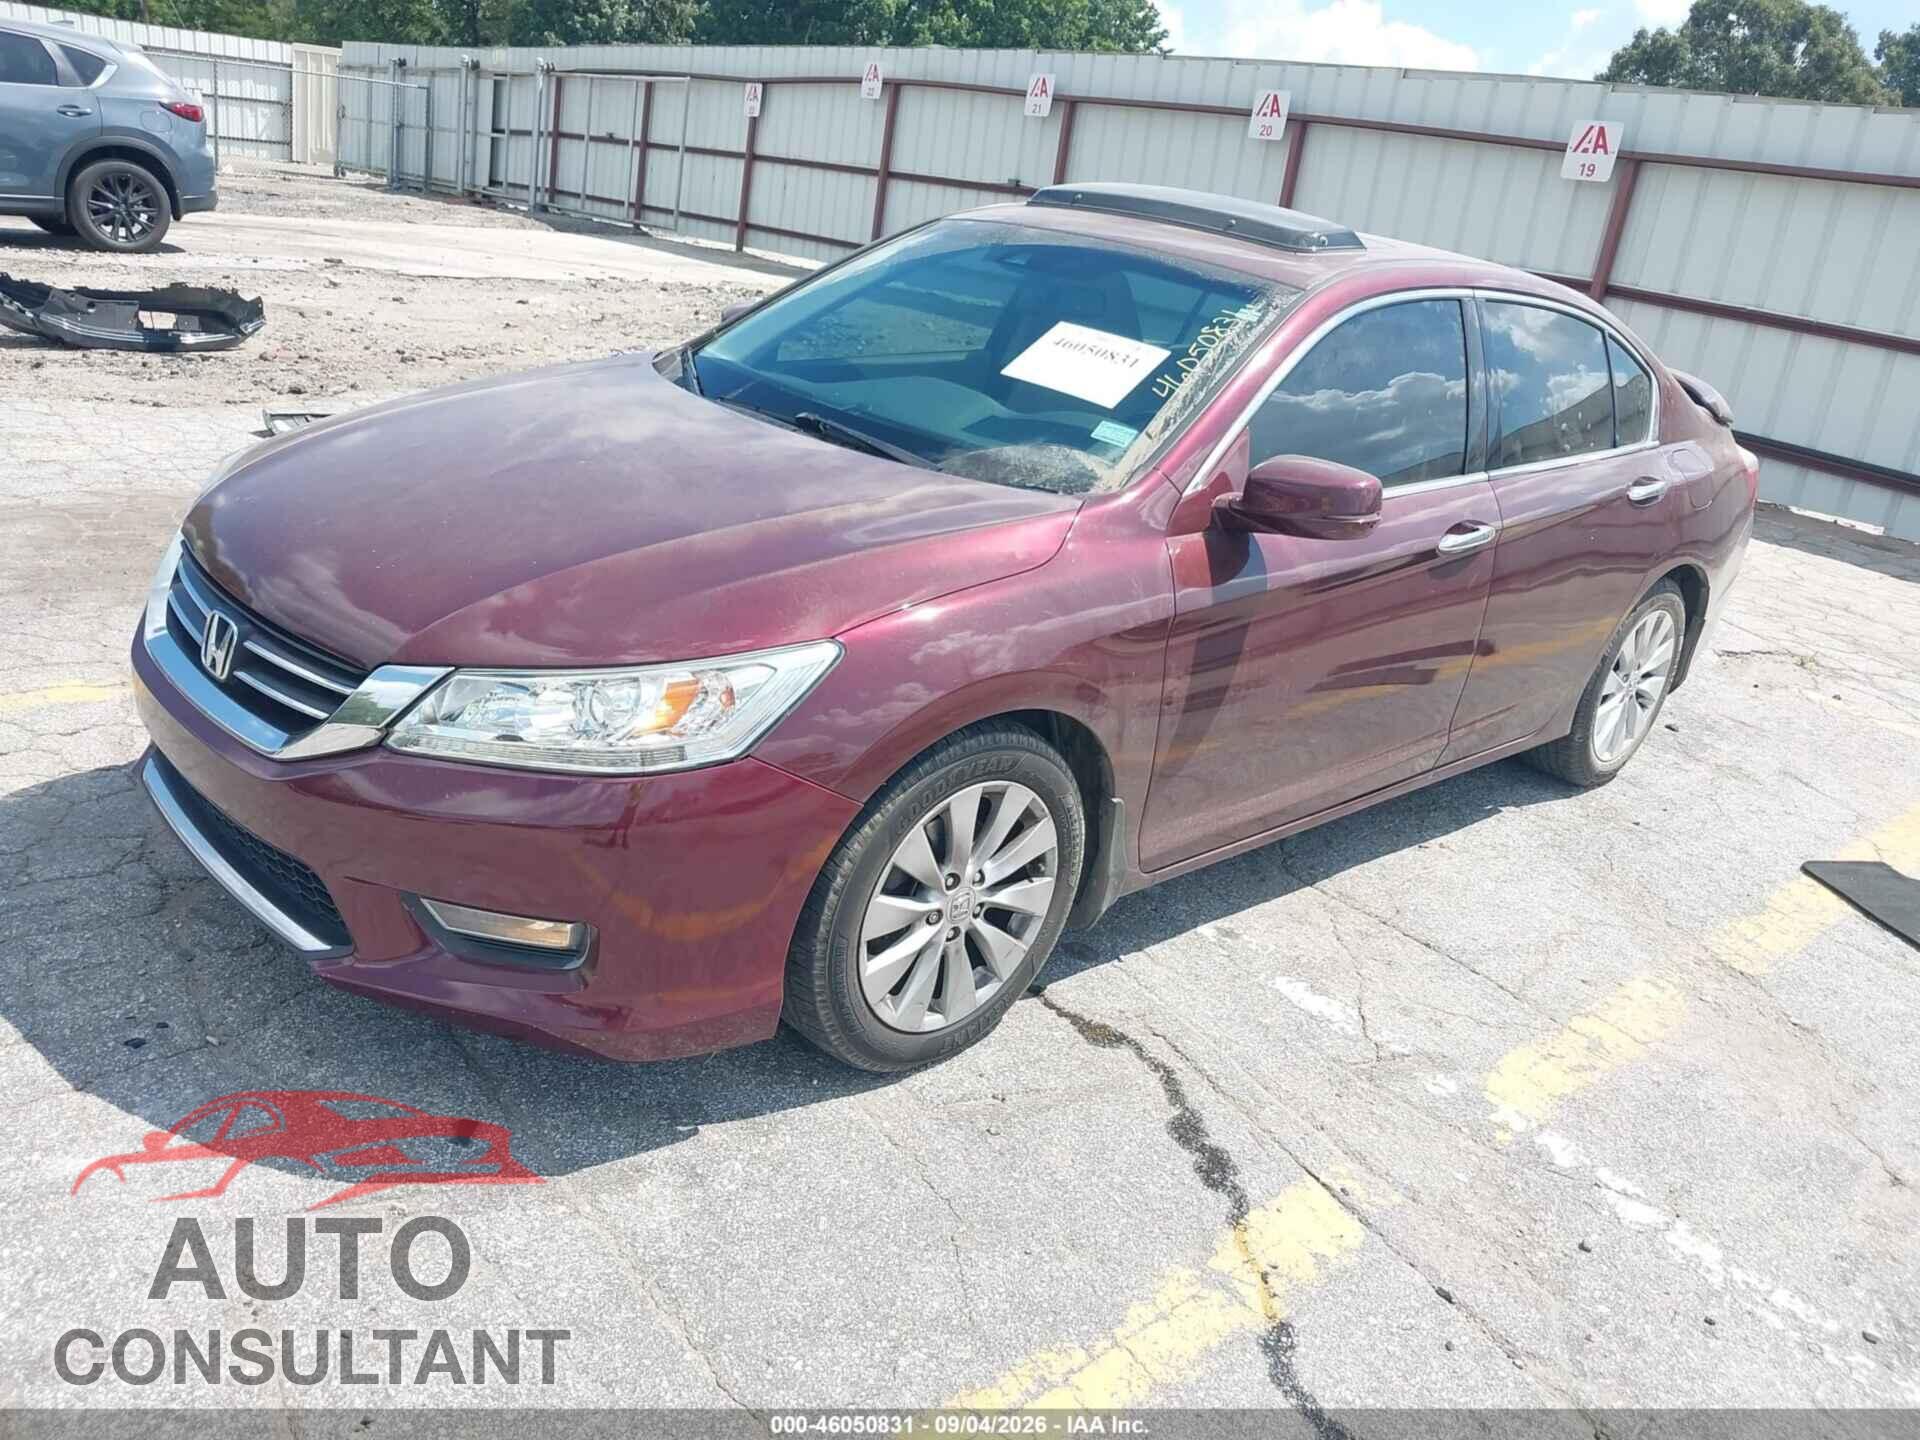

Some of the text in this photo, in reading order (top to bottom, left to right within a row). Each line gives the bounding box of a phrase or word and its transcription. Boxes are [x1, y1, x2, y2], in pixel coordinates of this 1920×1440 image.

[1031, 103, 1041, 113] 21
[1259, 124, 1272, 136] 20
[1579, 163, 1596, 177] 19
